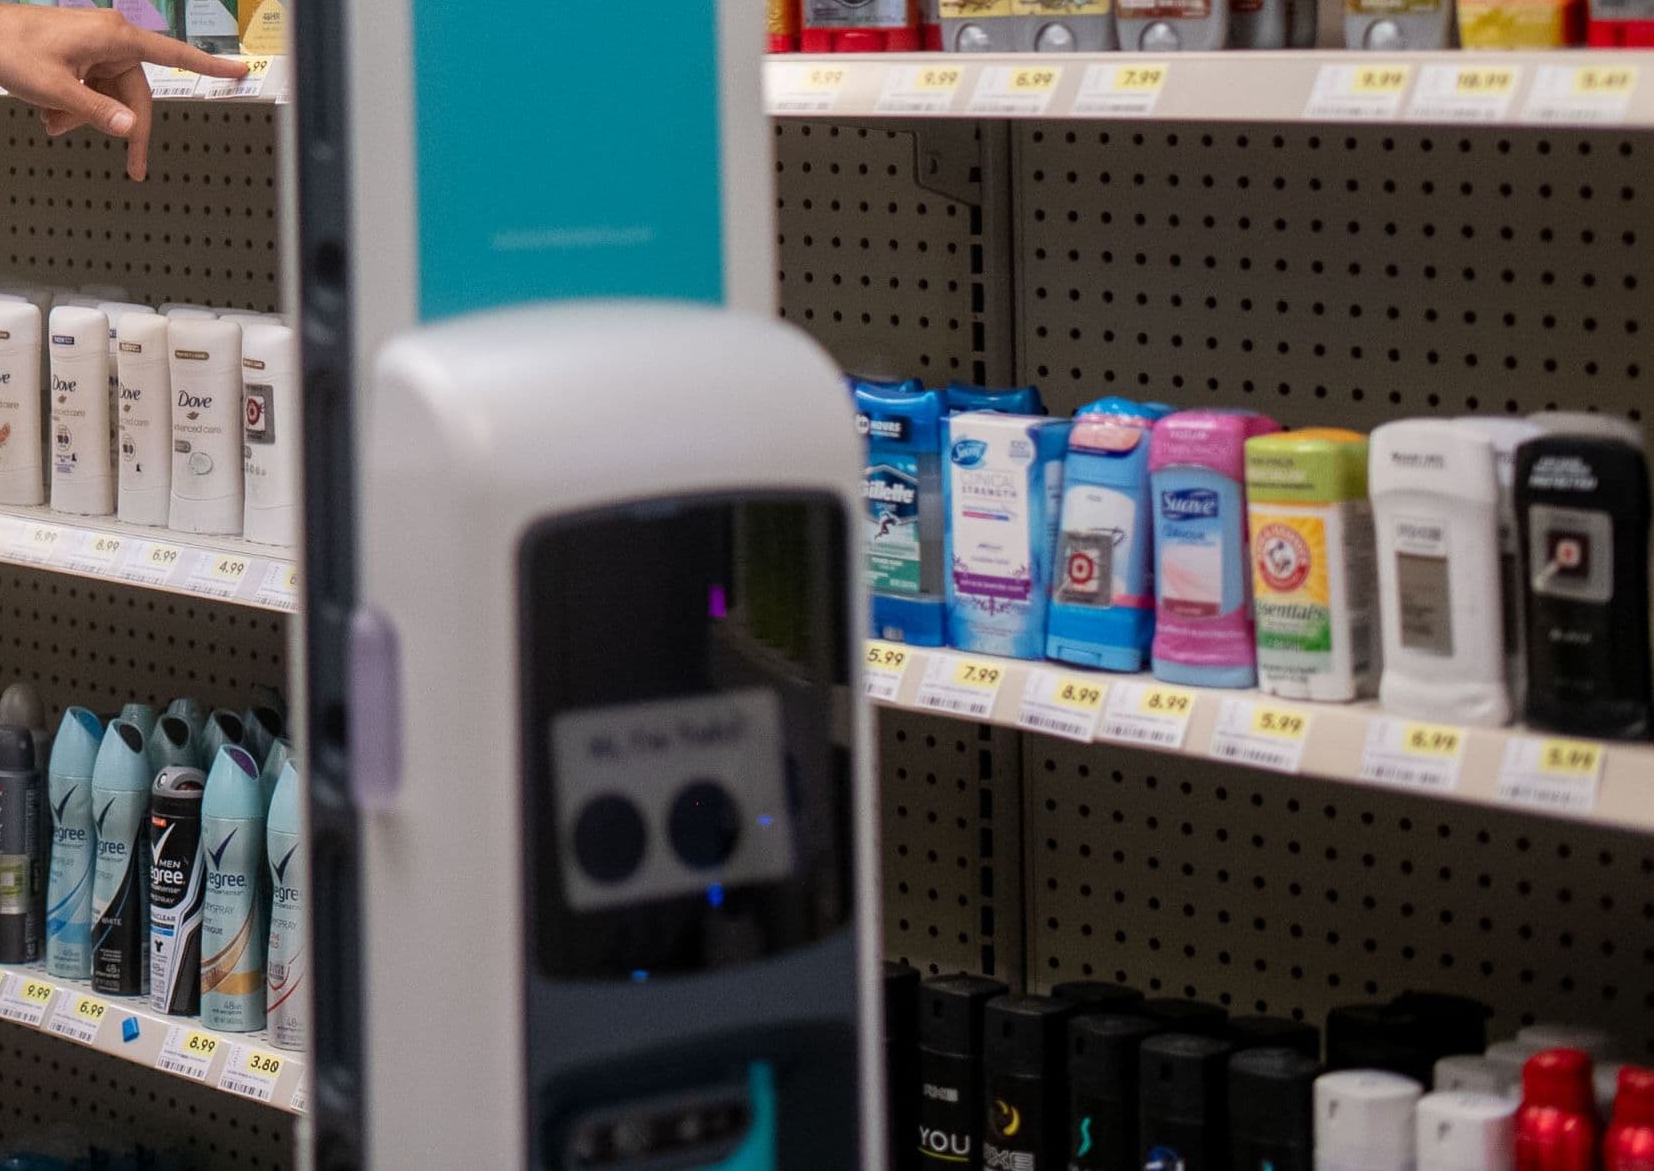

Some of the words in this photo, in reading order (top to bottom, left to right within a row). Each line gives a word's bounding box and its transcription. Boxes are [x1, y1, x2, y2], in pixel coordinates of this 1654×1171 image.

[1123, 71, 1161, 85] 7.99
[53, 374, 76, 392] Dove
[120, 382, 141, 401] Dove
[178, 390, 212, 409] Dove
[961, 487, 1018, 498] STRENGTH
[1163, 492, 1213, 513] Suave
[152, 549, 177, 562] 6.99
[219, 561, 244, 574] 4.99
[867, 648, 906, 667] 5.99
[964, 666, 999, 682] 7.99
[1260, 712, 1303, 733] 5.99
[58, 829, 85, 842] gree
[98, 841, 125, 855] gree
[159, 859, 181, 869] MEN
[209, 872, 245, 889] egree
[274, 885, 299, 904] egre
[27, 985, 51, 999] 9.99
[80, 1002, 105, 1017] 6.99
[189, 1036, 216, 1052] 8.99
[250, 1054, 280, 1073] 3.80
[919, 1125, 971, 1156] YOU
